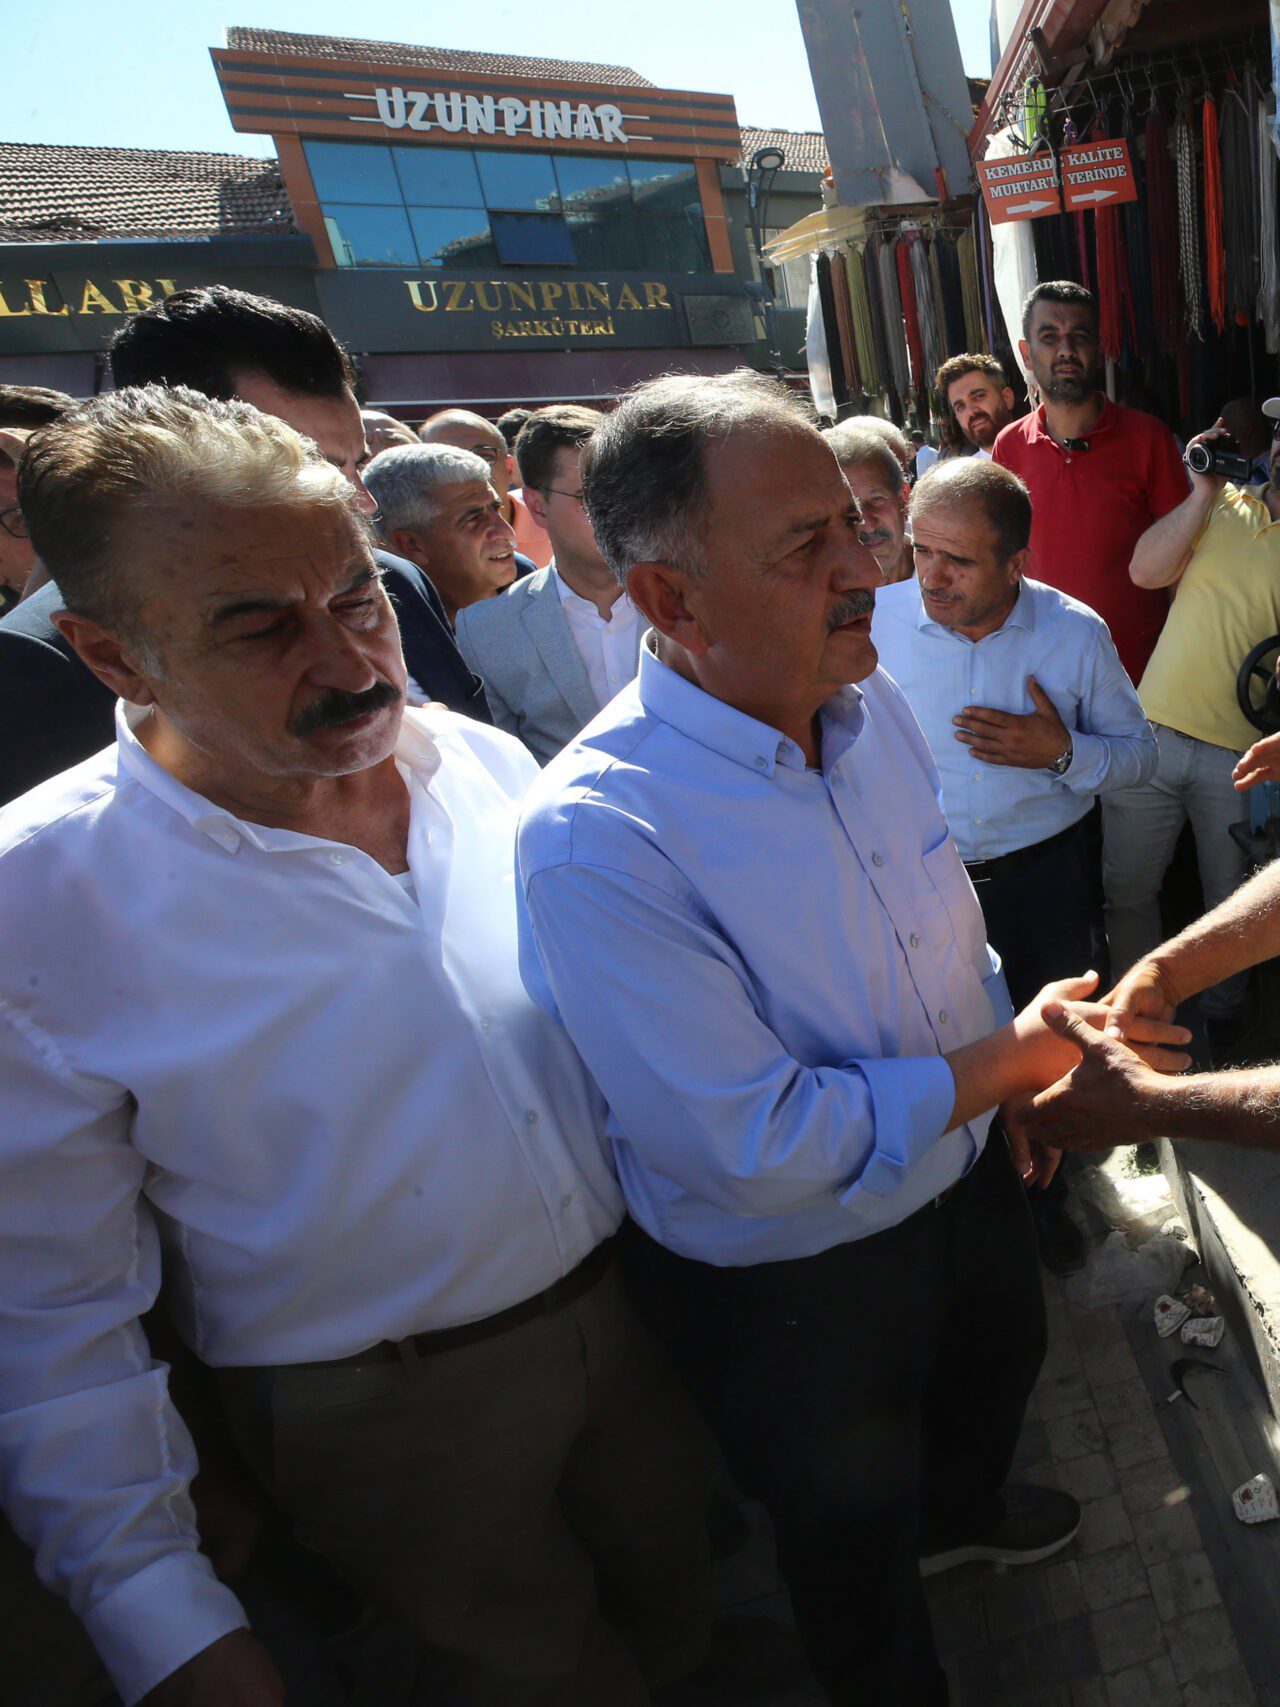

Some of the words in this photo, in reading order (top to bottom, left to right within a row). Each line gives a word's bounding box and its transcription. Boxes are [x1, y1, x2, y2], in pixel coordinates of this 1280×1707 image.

[375, 87, 628, 143] UZUNPINAR
[1067, 146, 1123, 166] KALİTE
[1066, 165, 1127, 185] YERİNDE
[403, 281, 674, 312] UZUNPINAR
[491, 316, 616, 340] ŞARKÜTERİ
